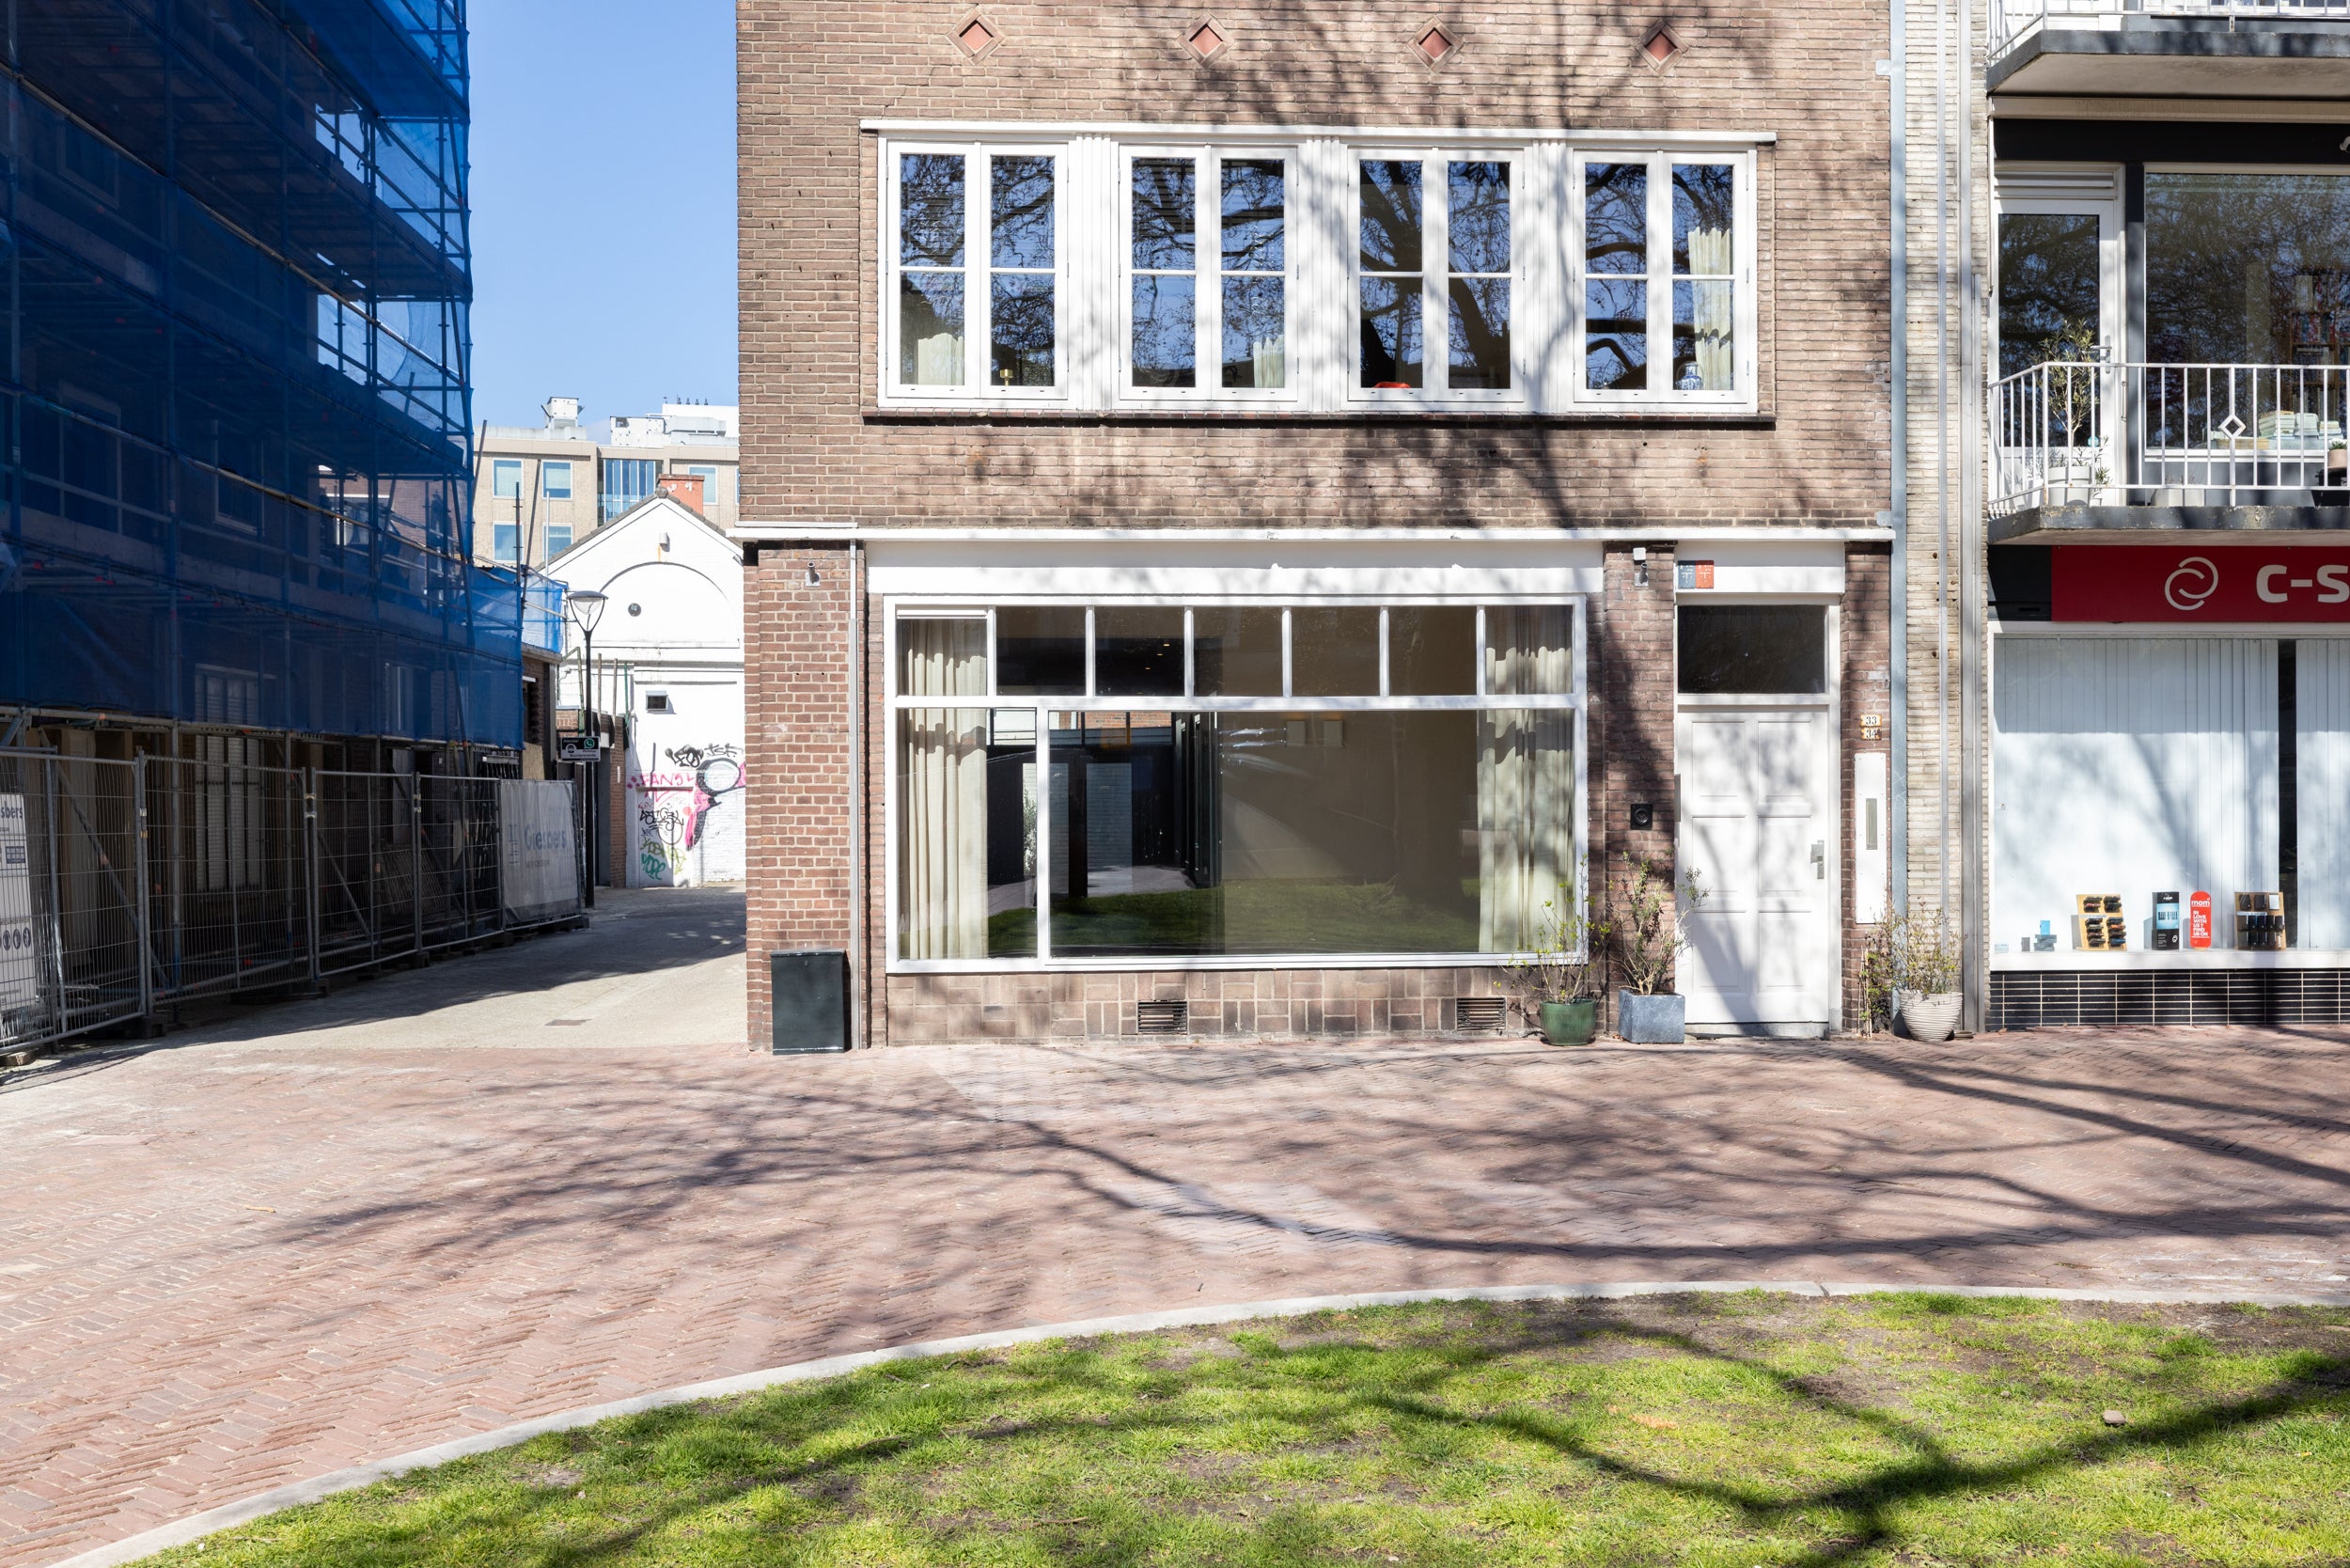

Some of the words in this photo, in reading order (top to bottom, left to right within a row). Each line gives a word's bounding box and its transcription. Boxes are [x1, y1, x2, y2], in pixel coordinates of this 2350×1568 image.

[2256, 564, 2350, 604] C-S
[1866, 716, 1877, 725] 33
[1866, 729, 1878, 738] 34
